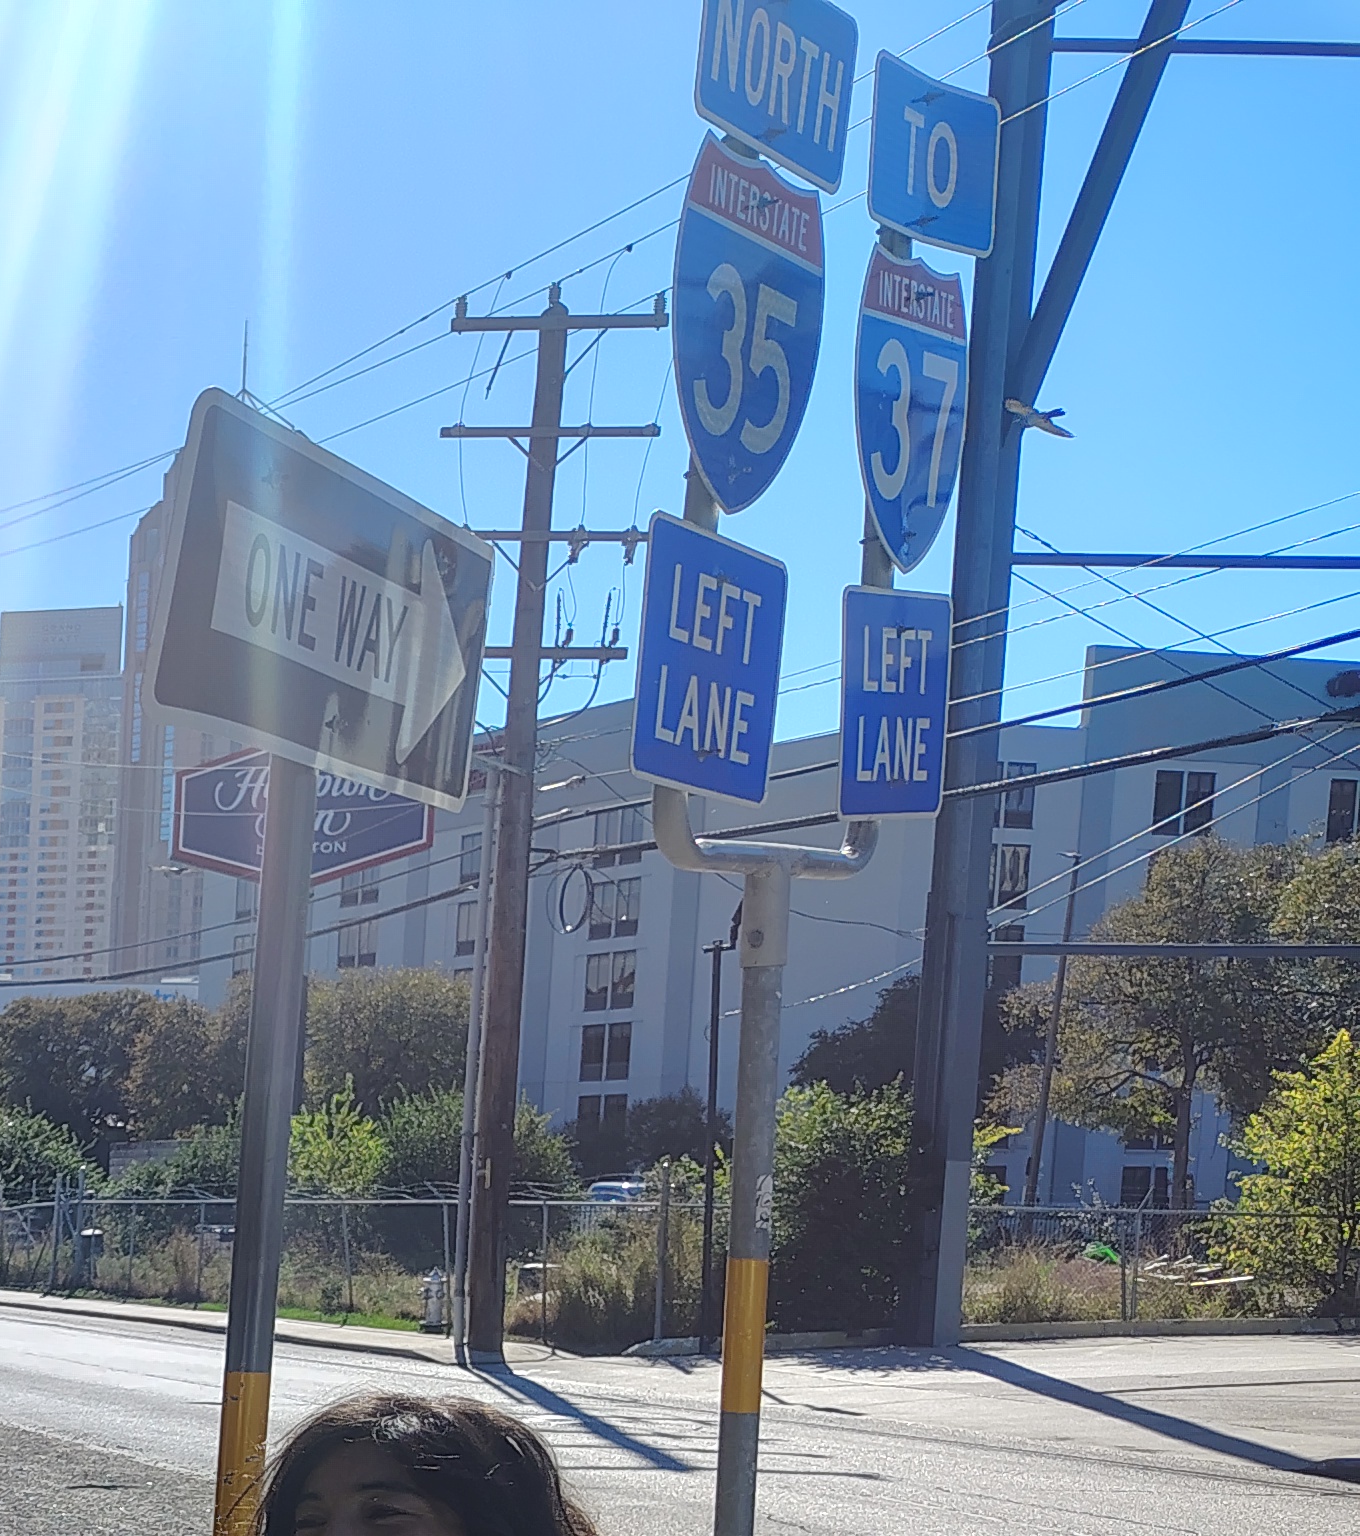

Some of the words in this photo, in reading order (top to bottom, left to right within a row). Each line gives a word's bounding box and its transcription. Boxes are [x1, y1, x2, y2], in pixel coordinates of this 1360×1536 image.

[711, 0, 844, 153] NORTH
[708, 162, 811, 254] INTERSTATE
[904, 106, 958, 208] TO
[878, 270, 955, 330] INTERSTATE
[694, 263, 797, 455] 35
[871, 338, 959, 508] 37
[245, 533, 324, 652] ONE
[334, 575, 409, 683] WAY
[669, 563, 762, 665] LEFT
[863, 625, 932, 694] LEFT
[655, 664, 755, 765] LANE
[856, 716, 930, 782] LANE
